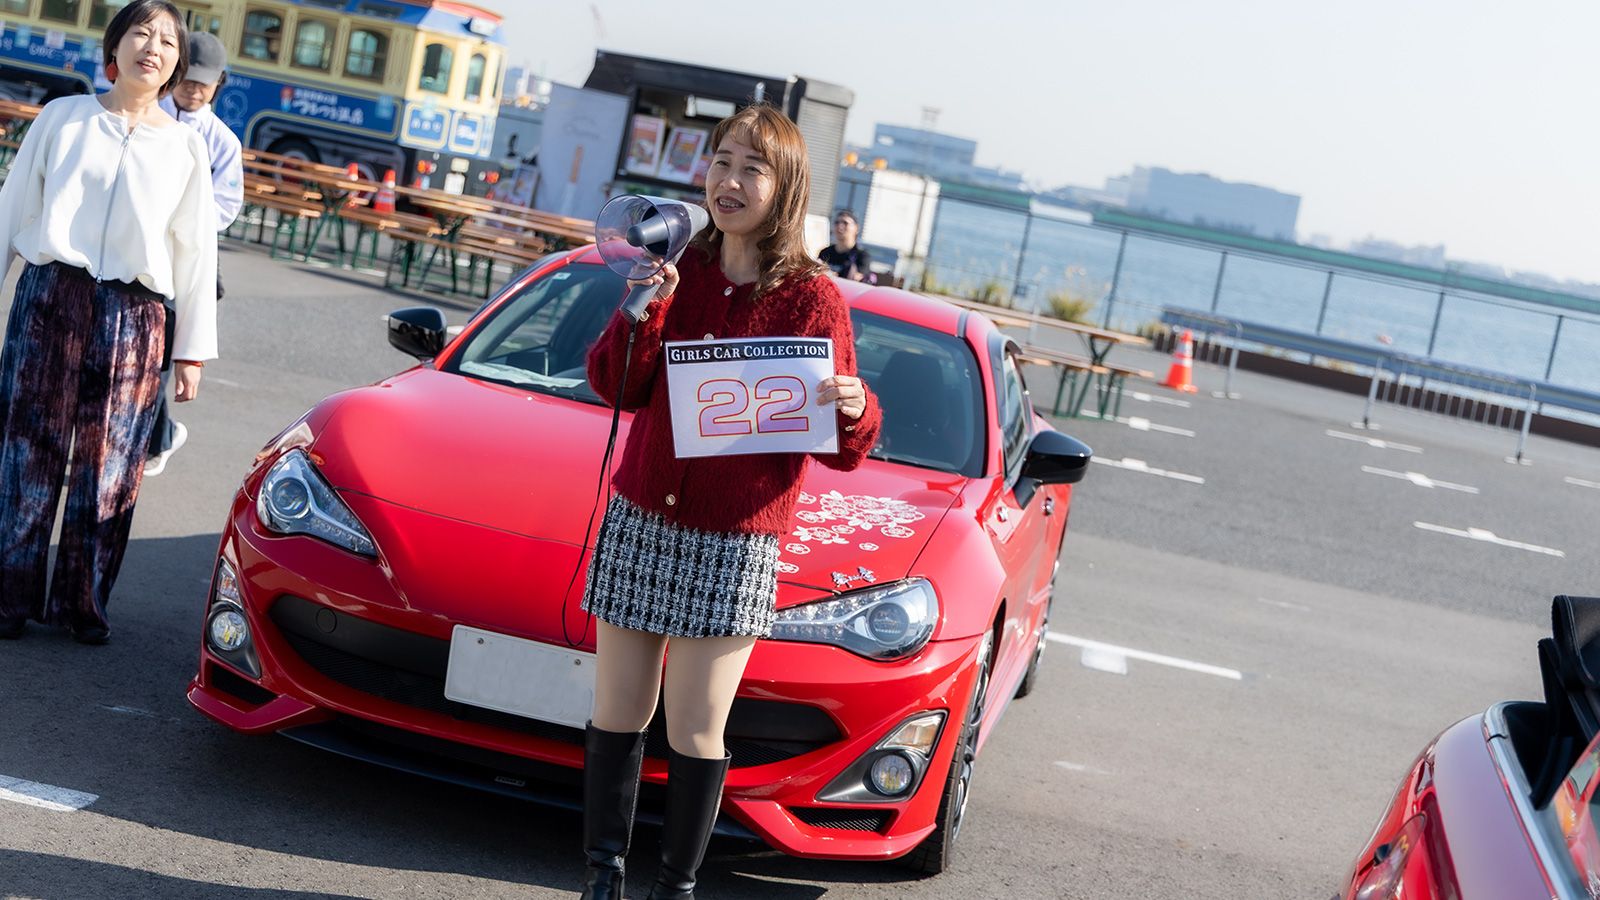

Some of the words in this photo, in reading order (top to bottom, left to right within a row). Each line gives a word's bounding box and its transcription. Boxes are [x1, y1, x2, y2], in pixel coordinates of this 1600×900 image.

[671, 348, 711, 362] GIRLS
[713, 347, 741, 360] CAR
[743, 344, 827, 358] COLLECTION
[697, 375, 809, 437] 22
